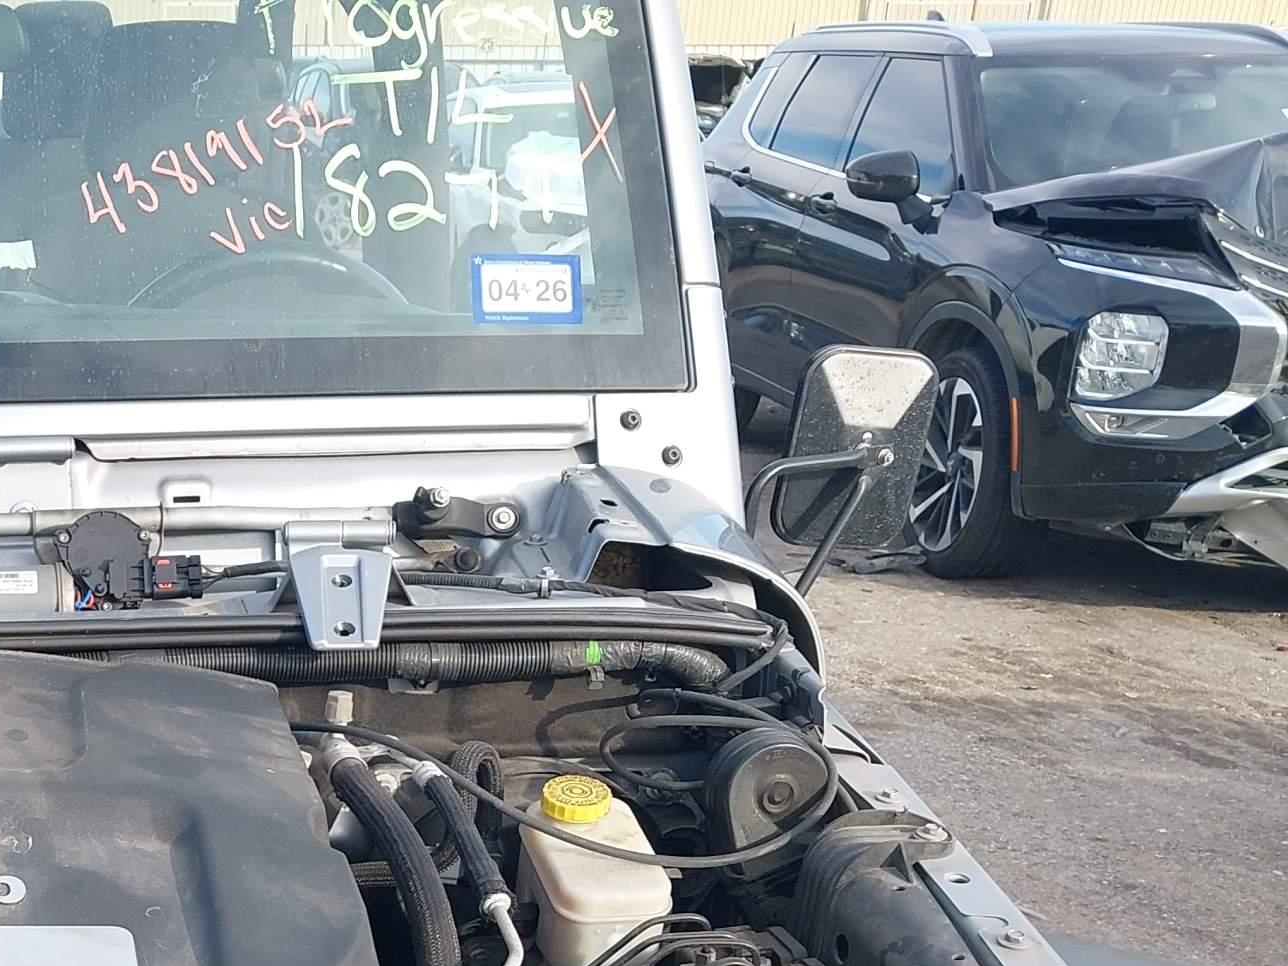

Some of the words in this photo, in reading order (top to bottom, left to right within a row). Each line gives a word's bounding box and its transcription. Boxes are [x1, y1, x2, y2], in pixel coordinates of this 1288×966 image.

[81, 99, 353, 233] 43819152
[488, 279, 520, 302] 04
[535, 279, 568, 302] 26
